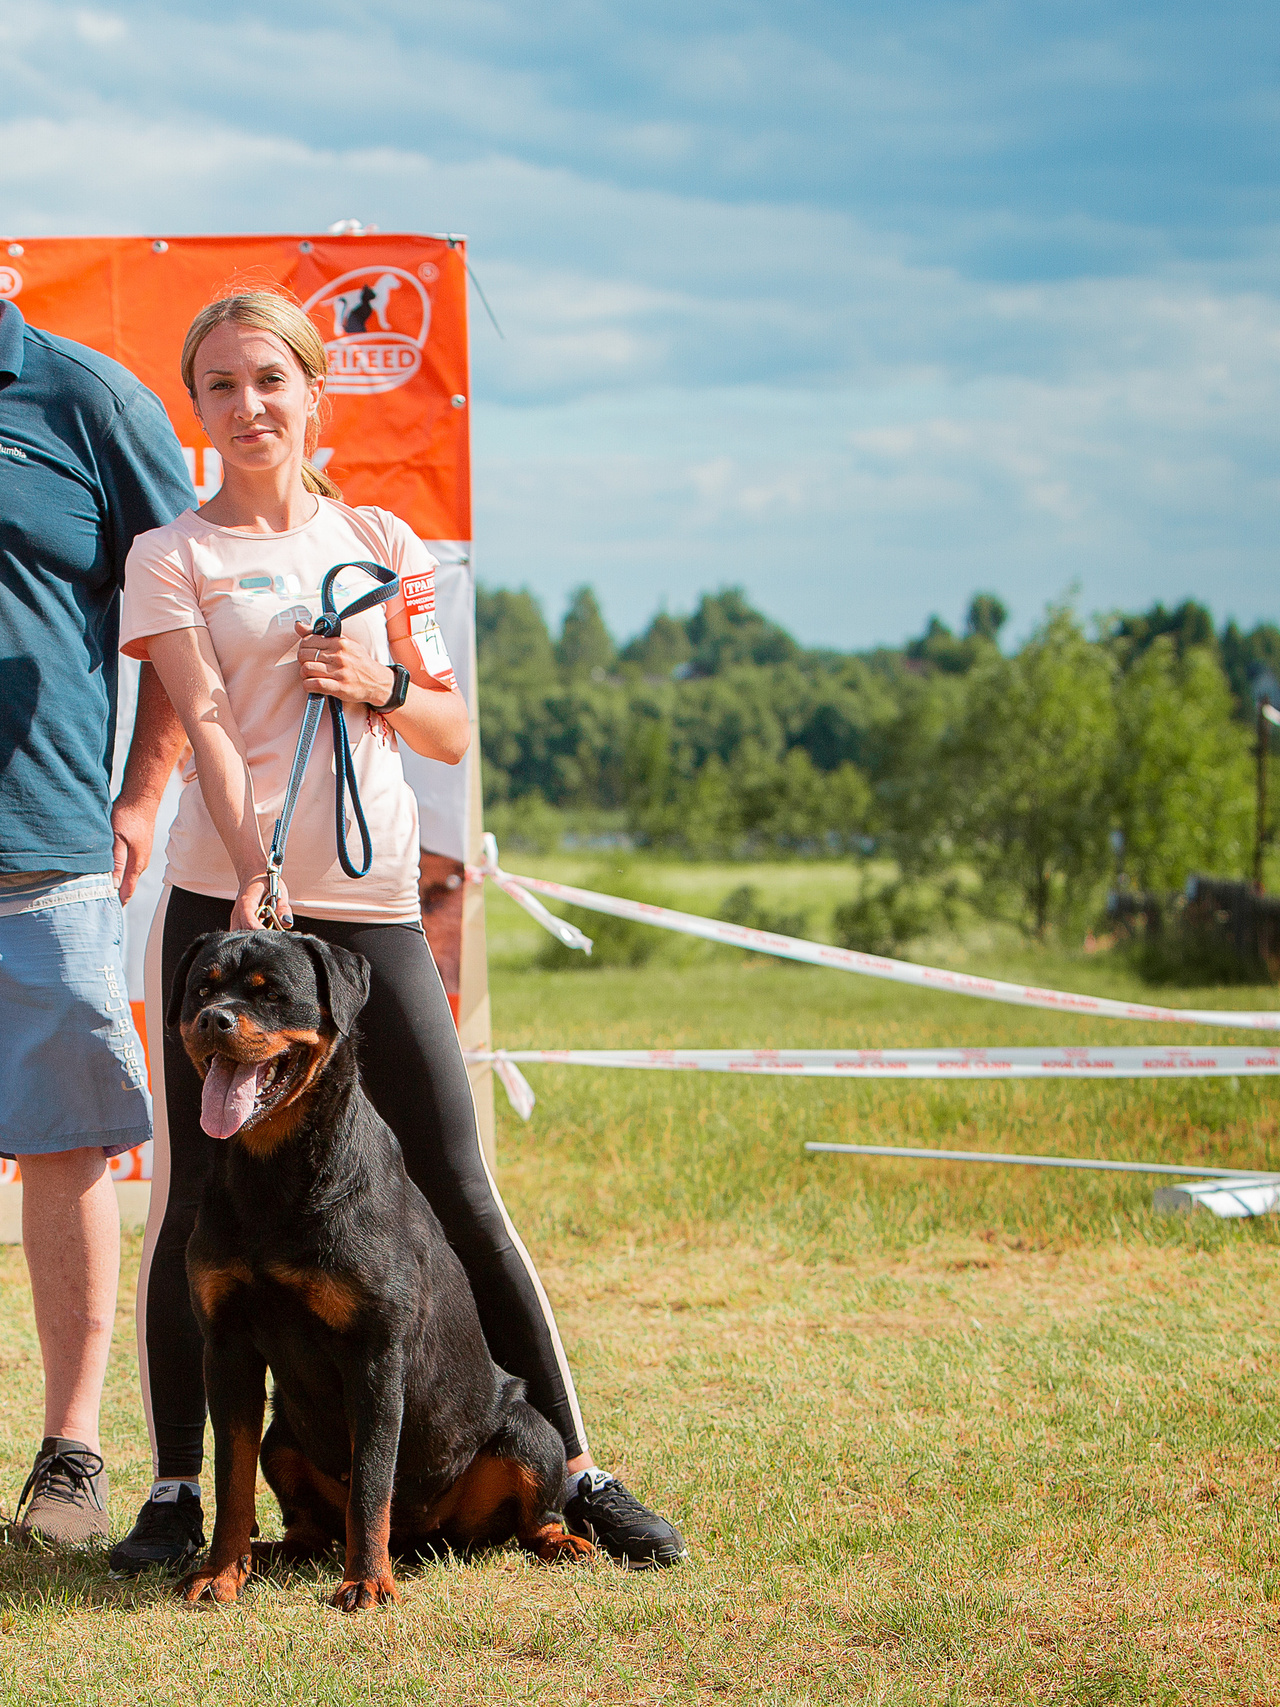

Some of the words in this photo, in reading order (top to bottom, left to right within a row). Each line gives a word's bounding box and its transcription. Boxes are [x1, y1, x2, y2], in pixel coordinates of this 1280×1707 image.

[95, 964, 125, 1012] Coast
[110, 1018, 131, 1037] to
[114, 1041, 144, 1091] Coast
